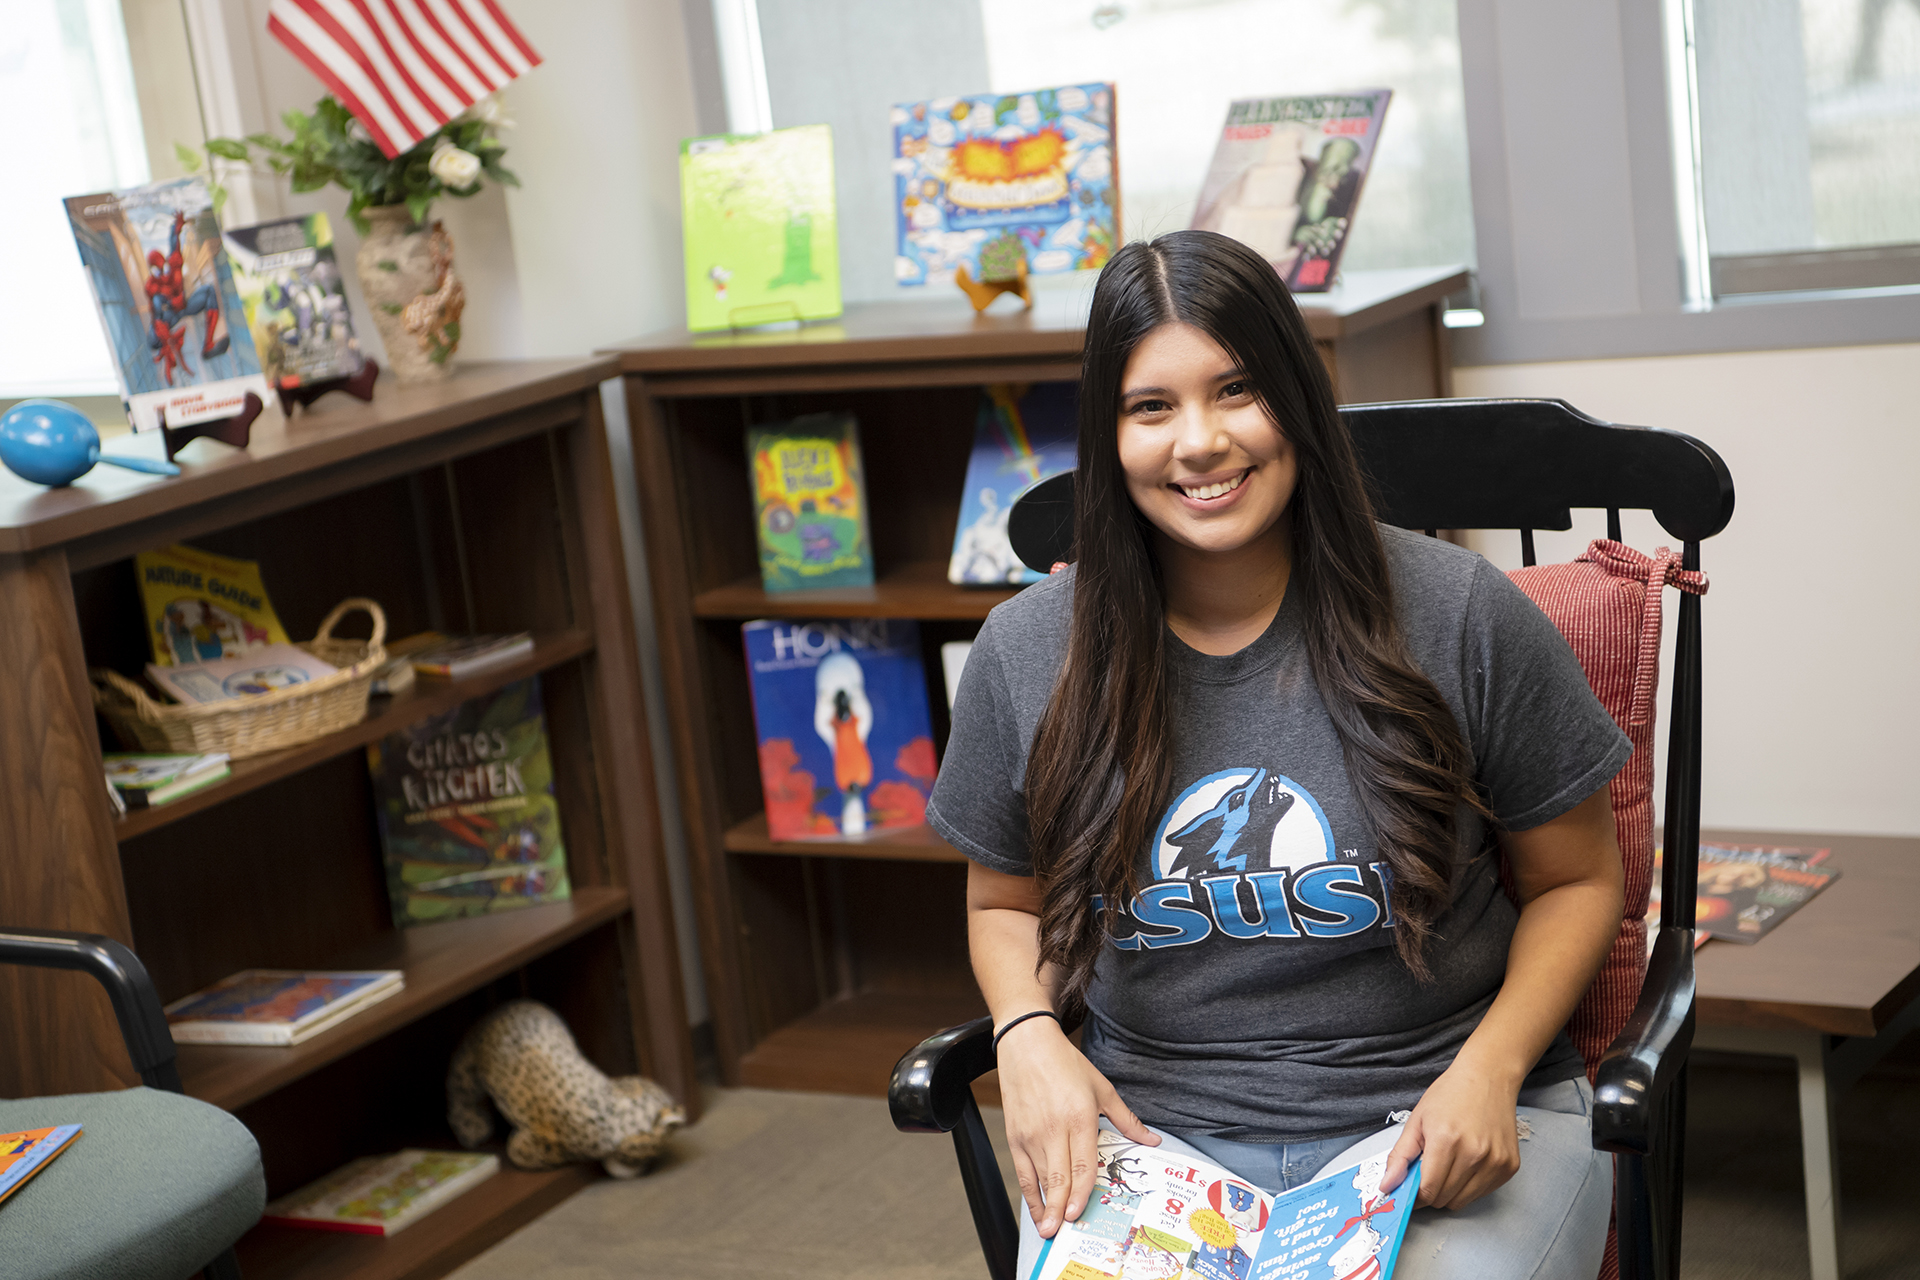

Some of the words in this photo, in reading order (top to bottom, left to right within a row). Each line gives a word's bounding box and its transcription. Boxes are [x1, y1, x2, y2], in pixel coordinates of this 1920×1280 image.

[144, 565, 203, 591] NATURE
[207, 578, 261, 610] GUIDE
[401, 756, 527, 811] KITCHEN
[1343, 848, 1359, 859] TM
[1165, 1181, 1183, 1191] only
[1185, 1188, 1197, 1197] for
[1166, 1188, 1191, 1202] books
[1165, 1198, 1185, 1215] 8
[1295, 1199, 1328, 1220] too!
[1159, 1211, 1182, 1224] these
[1307, 1206, 1340, 1224] free
[1160, 1219, 1175, 1229] Get
[1274, 1217, 1307, 1238] gift,
[1092, 1228, 1106, 1236] You
[1200, 1224, 1225, 1239] FREE
[1291, 1223, 1326, 1246] And
[1081, 1239, 1109, 1252] WHEELS
[1280, 1237, 1290, 1247] a
[1291, 1234, 1335, 1259] Great
[1078, 1245, 1102, 1258] BEARS
[1087, 1245, 1099, 1253] ON
[1131, 1257, 1155, 1265] House
[1197, 1257, 1218, 1275] BACK
[1256, 1252, 1290, 1274] fun!
[1141, 1265, 1170, 1276] People
